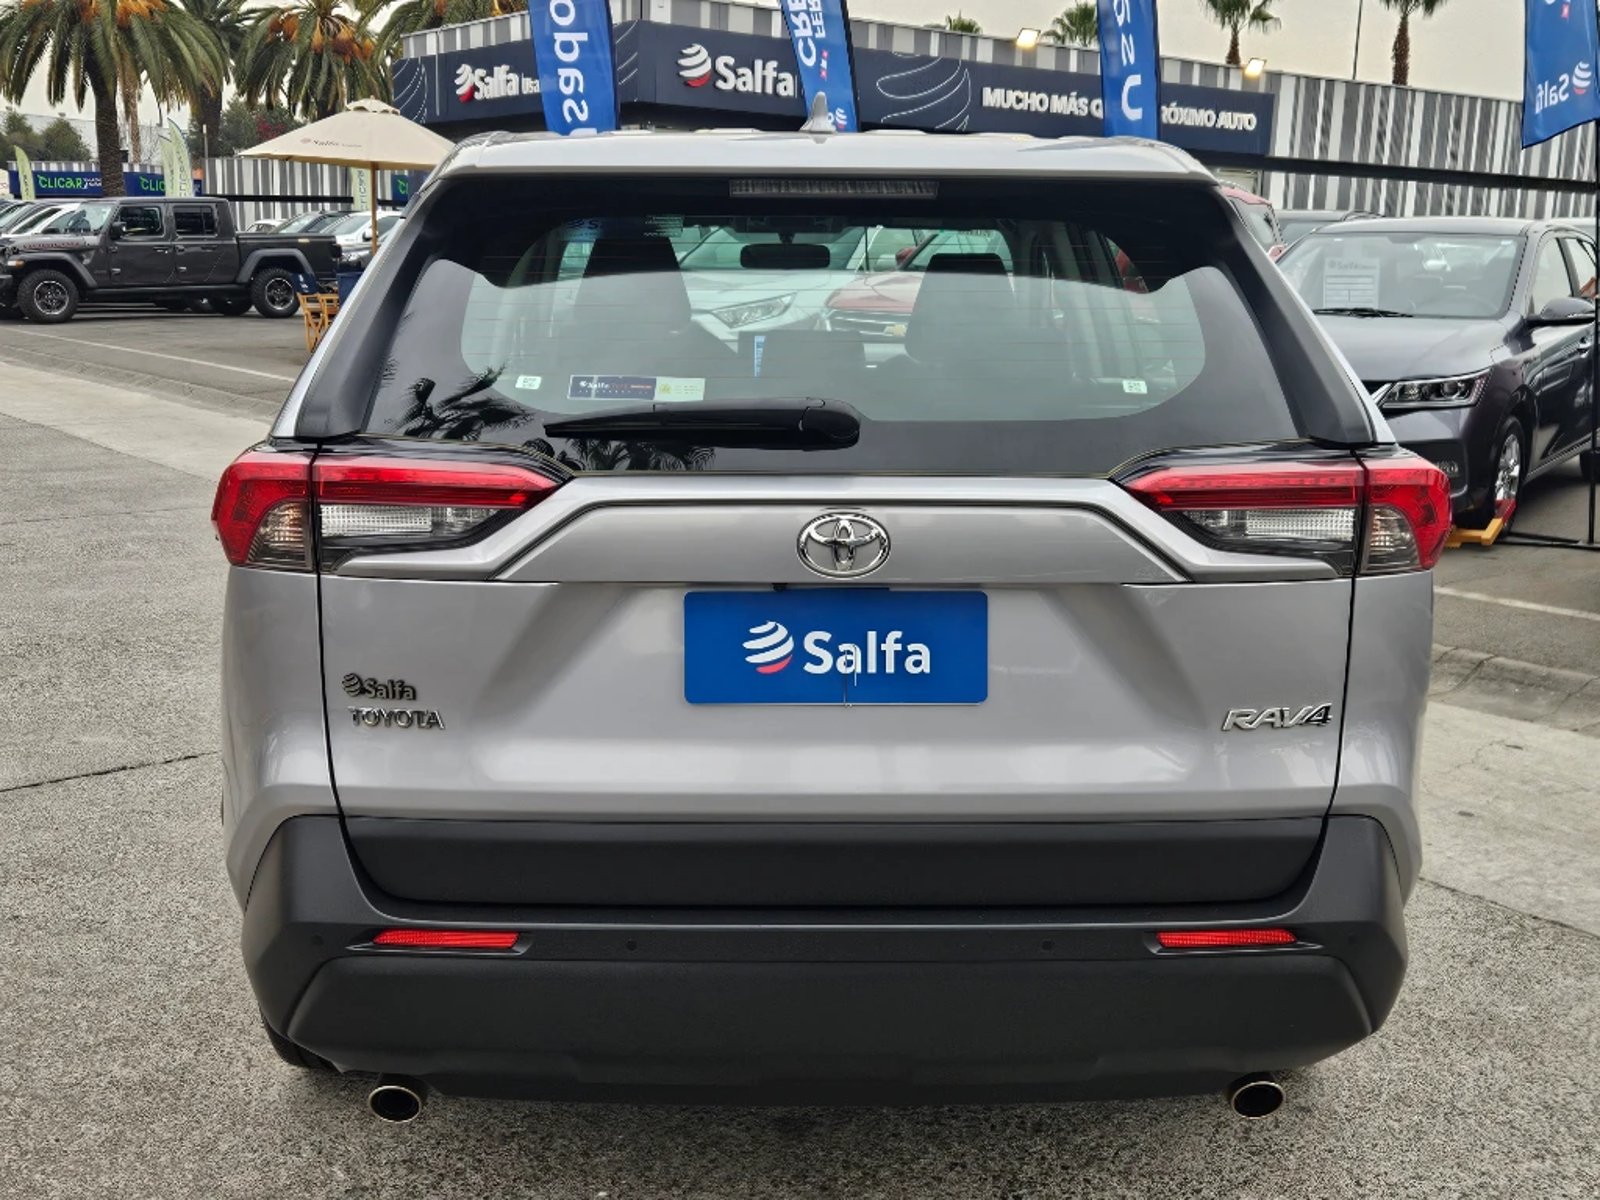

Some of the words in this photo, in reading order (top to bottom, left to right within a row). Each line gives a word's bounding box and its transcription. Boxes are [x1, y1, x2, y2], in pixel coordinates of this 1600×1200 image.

[474, 65, 520, 100] Salfa
[714, 55, 795, 97] Salfa
[982, 86, 1049, 112] MUCHO
[1049, 91, 1088, 117] MÁS
[1216, 110, 1257, 131] AUTO
[803, 630, 931, 675] Salfa
[362, 677, 417, 700] Salfa
[347, 705, 445, 730] TOYOTA
[1221, 702, 1333, 731] RAV4
